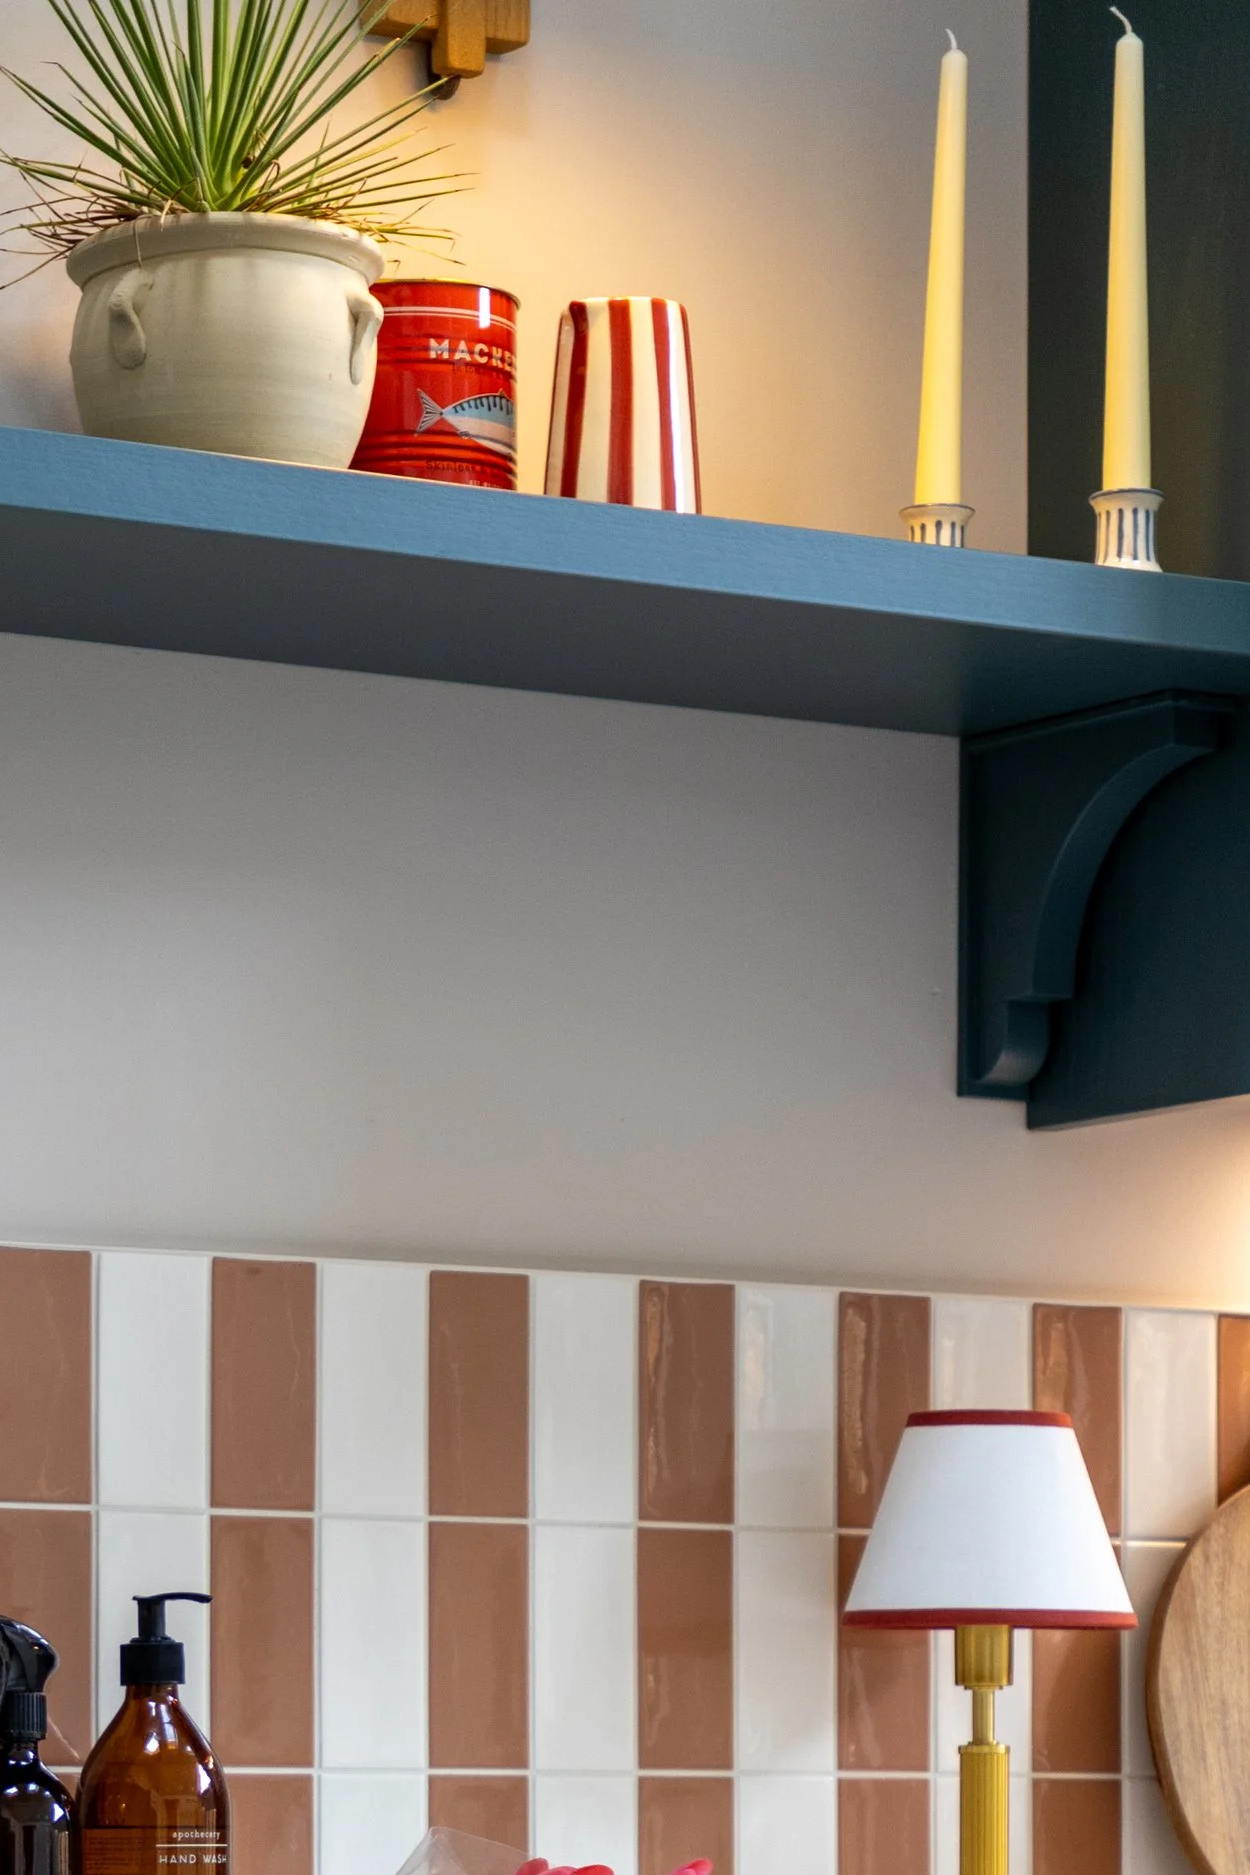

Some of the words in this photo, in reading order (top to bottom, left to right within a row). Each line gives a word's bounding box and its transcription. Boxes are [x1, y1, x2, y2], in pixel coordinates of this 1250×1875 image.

[429, 337, 516, 374] MACKE
[172, 1829, 221, 1841] apothecary
[159, 1854, 197, 1864] HAND
[202, 1853, 228, 1864] WASH
